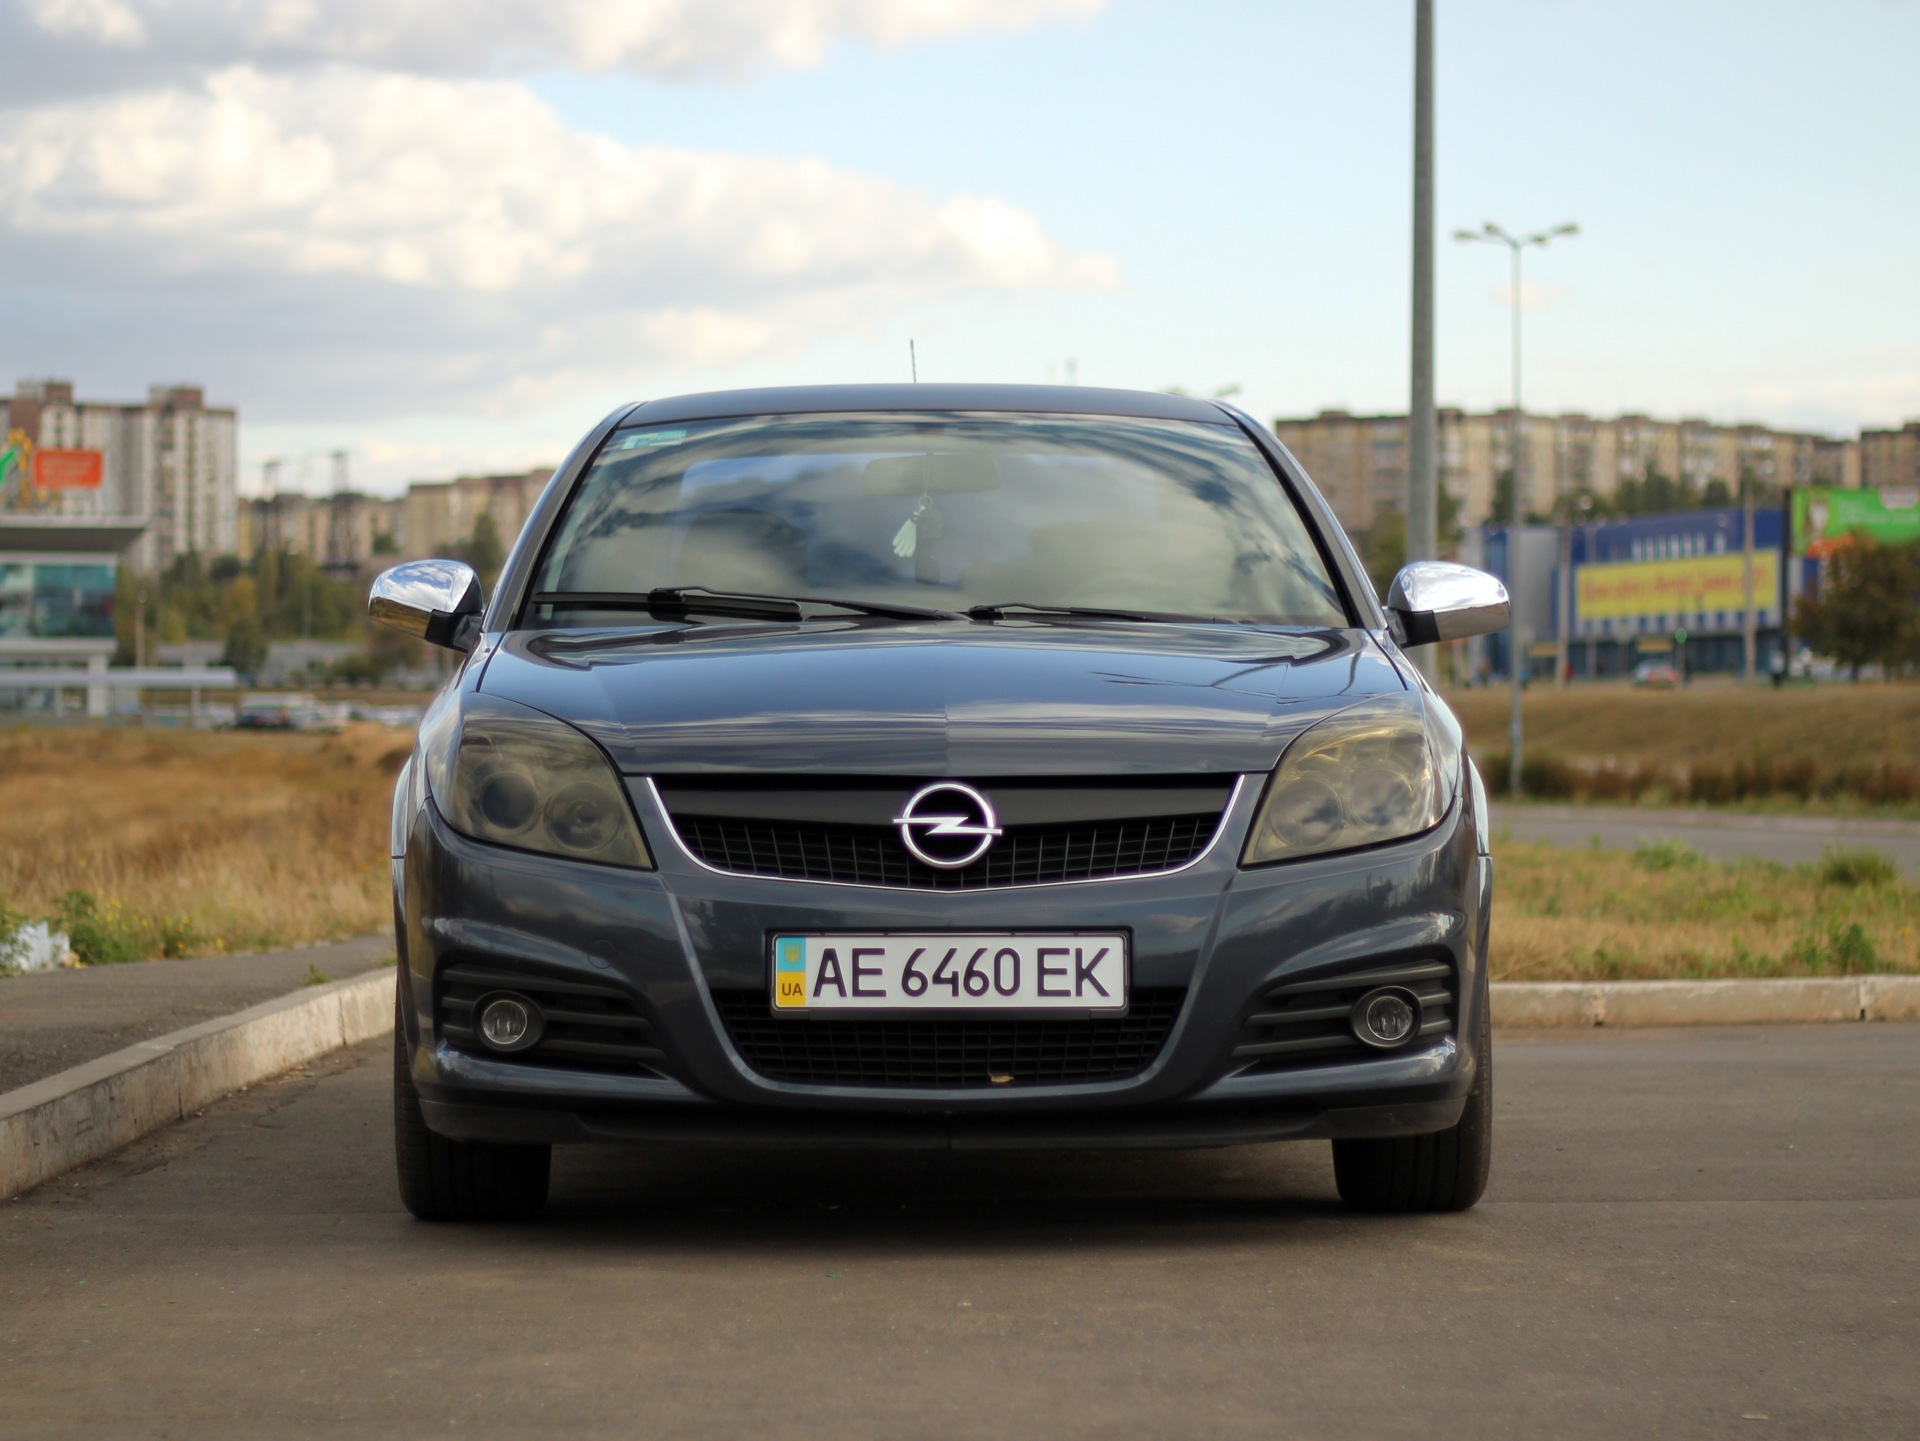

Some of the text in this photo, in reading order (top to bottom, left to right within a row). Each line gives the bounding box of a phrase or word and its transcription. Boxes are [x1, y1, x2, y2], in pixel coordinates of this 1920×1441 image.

[812, 947, 1110, 998] AE 6460 EK
[782, 983, 803, 997] UA
